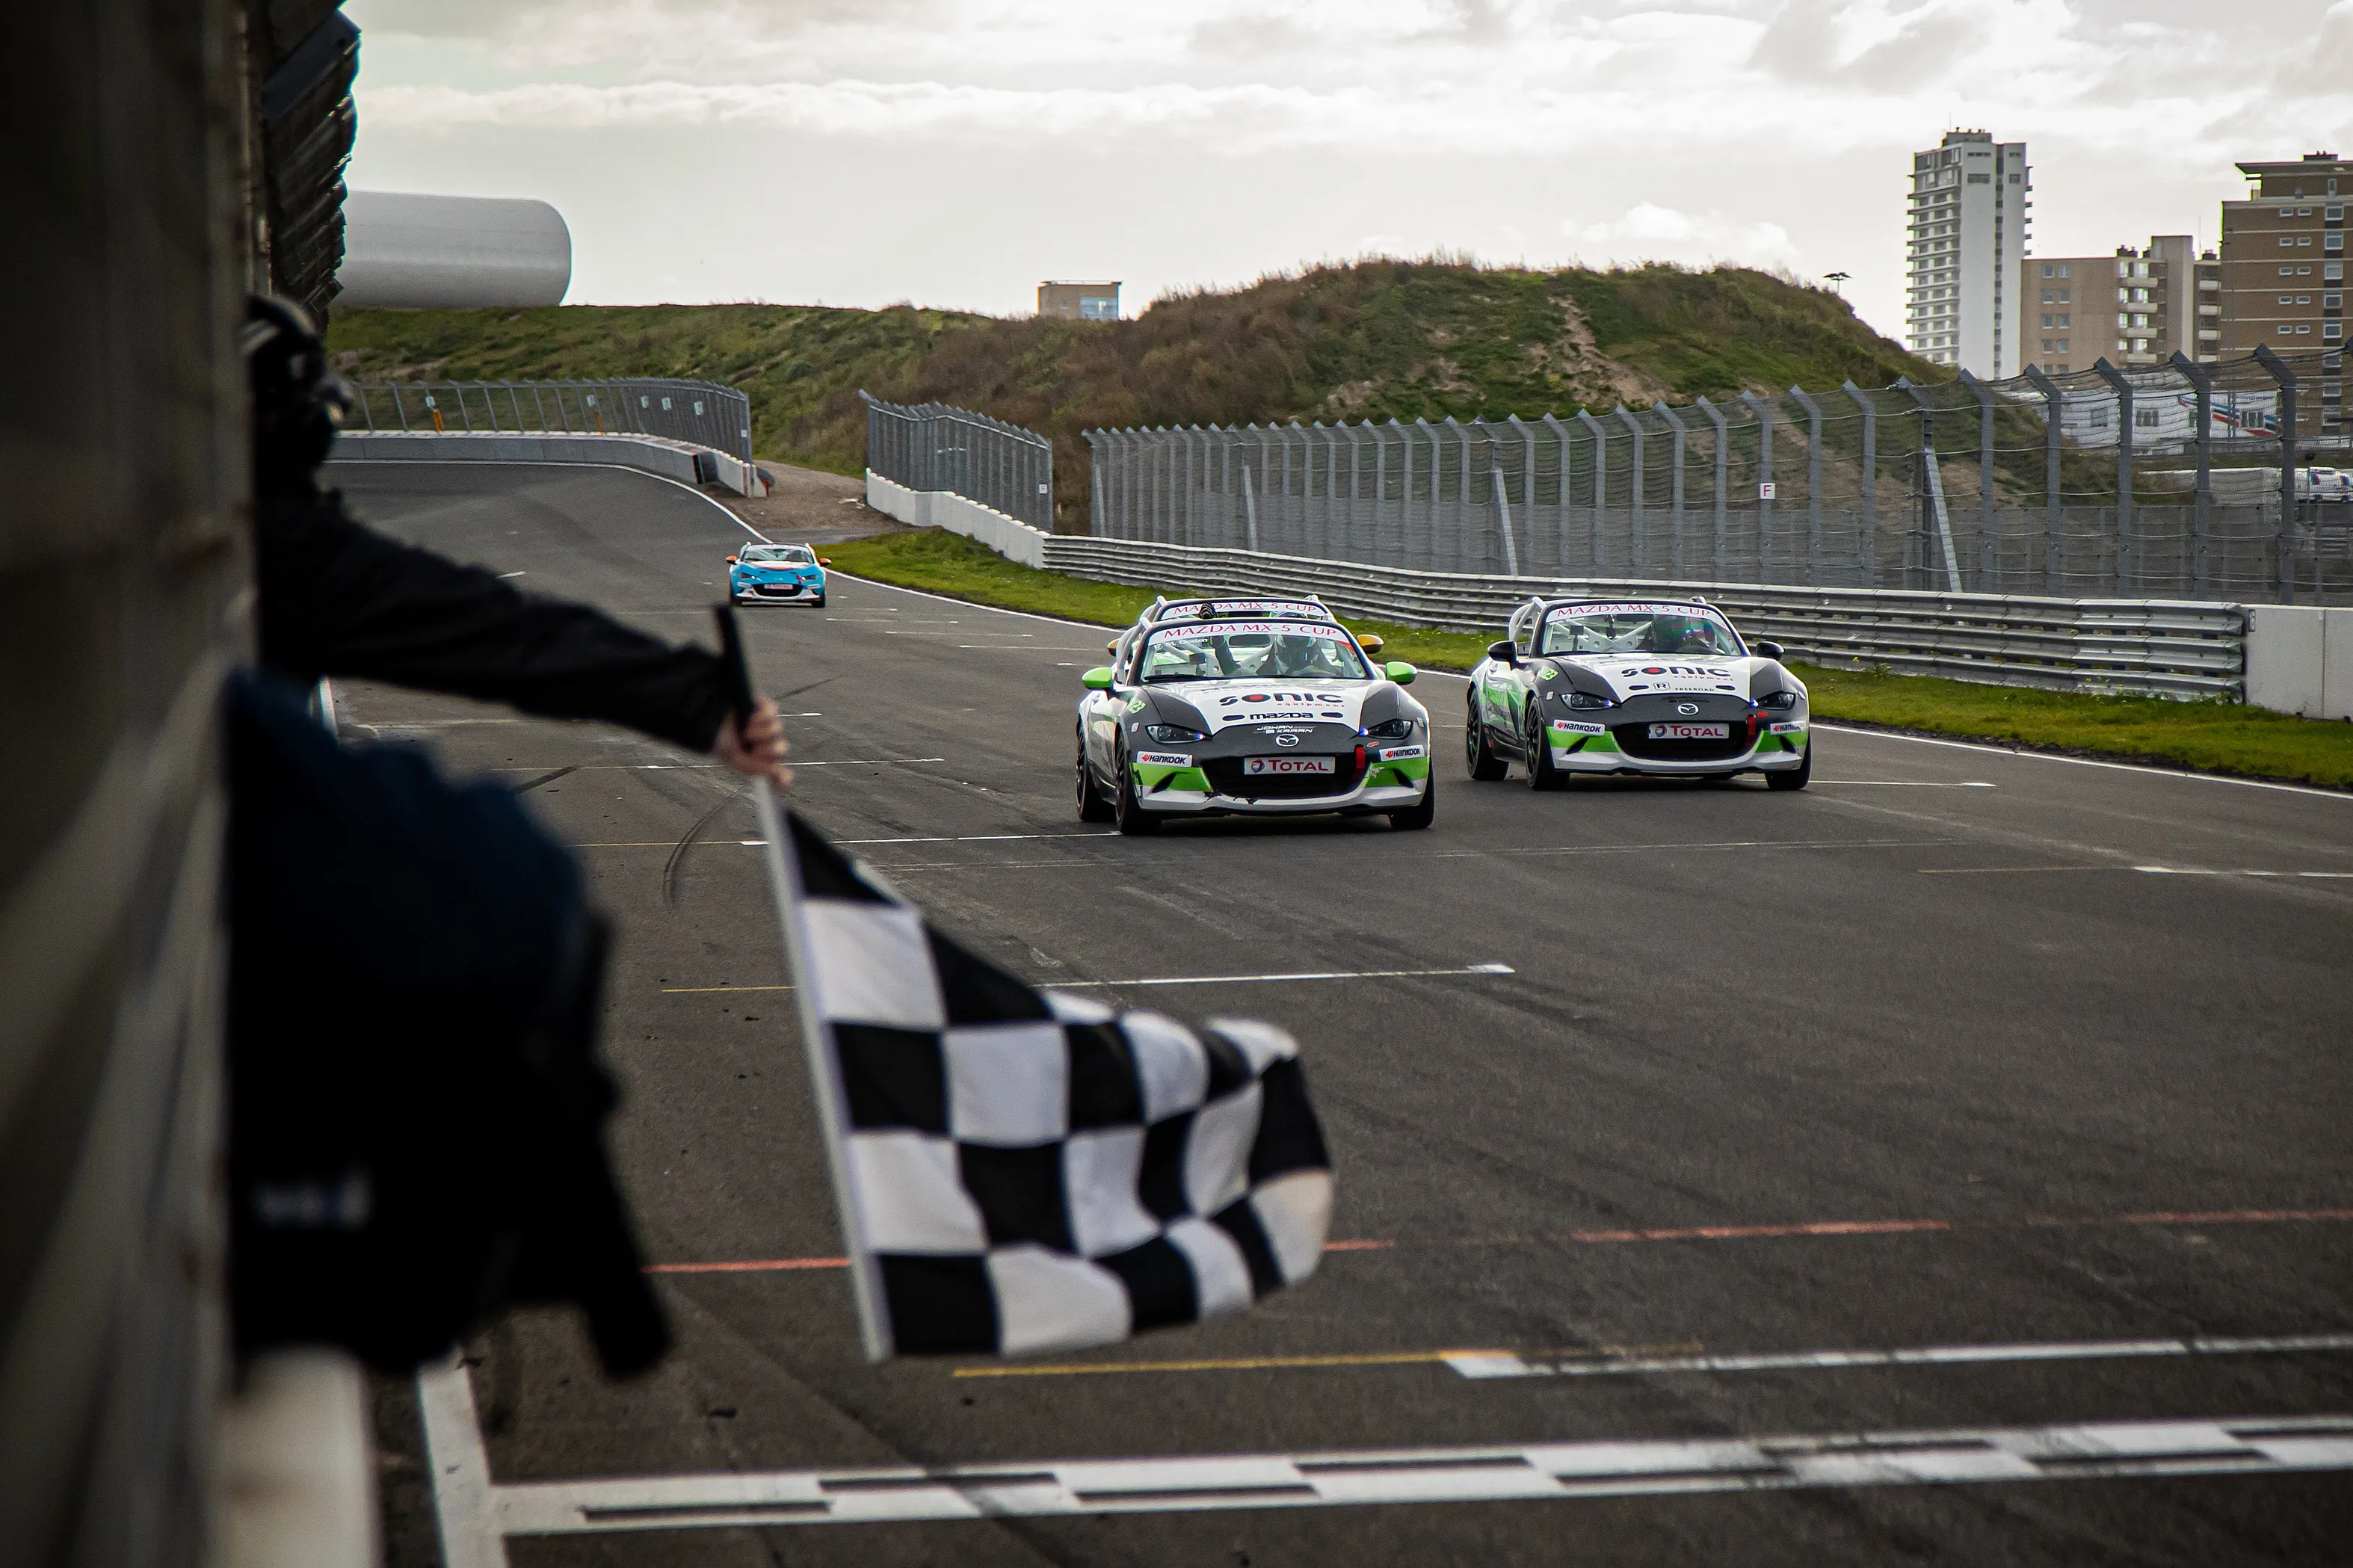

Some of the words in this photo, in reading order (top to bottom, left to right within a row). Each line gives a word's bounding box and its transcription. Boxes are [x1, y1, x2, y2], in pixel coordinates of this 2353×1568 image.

[1763, 484, 1772, 497] F
[1174, 603, 1233, 614] MADA
[1285, 603, 1316, 611] CUP
[1557, 605, 1622, 617] MAZDA
[1627, 605, 1670, 613] MX-5
[1677, 605, 1711, 616] CUP
[1165, 624, 1237, 638] MAZDA
[1242, 624, 1292, 633] MX-5
[1299, 626, 1336, 635] CUP
[1621, 666, 1731, 677] sonic
[1219, 692, 1344, 706] sonic
[1250, 712, 1314, 720] mazda
[1564, 722, 1602, 733] Hankook
[1670, 725, 1724, 737] TOTAL
[1393, 748, 1421, 757] Hankook
[1149, 755, 1186, 765] Hankook
[1268, 759, 1329, 771] TOTAL
